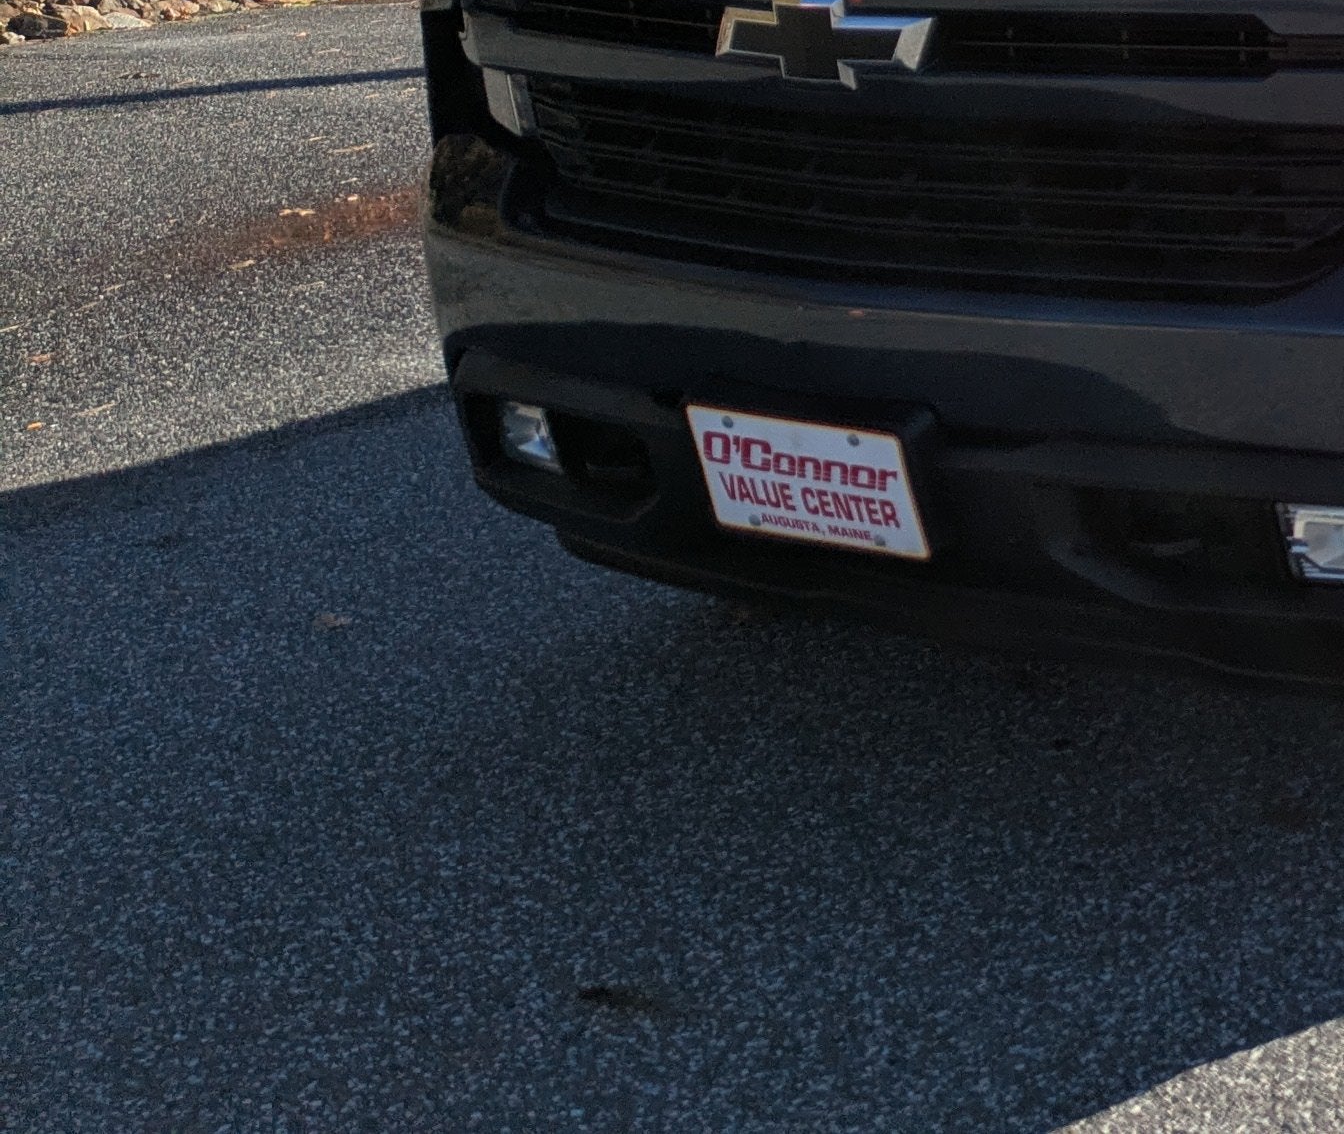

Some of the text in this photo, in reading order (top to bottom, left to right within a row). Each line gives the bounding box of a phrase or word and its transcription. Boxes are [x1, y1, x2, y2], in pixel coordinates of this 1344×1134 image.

[703, 431, 897, 492] O'Connor
[719, 471, 900, 528] VALUE CENTER
[828, 524, 873, 541] MAINE
